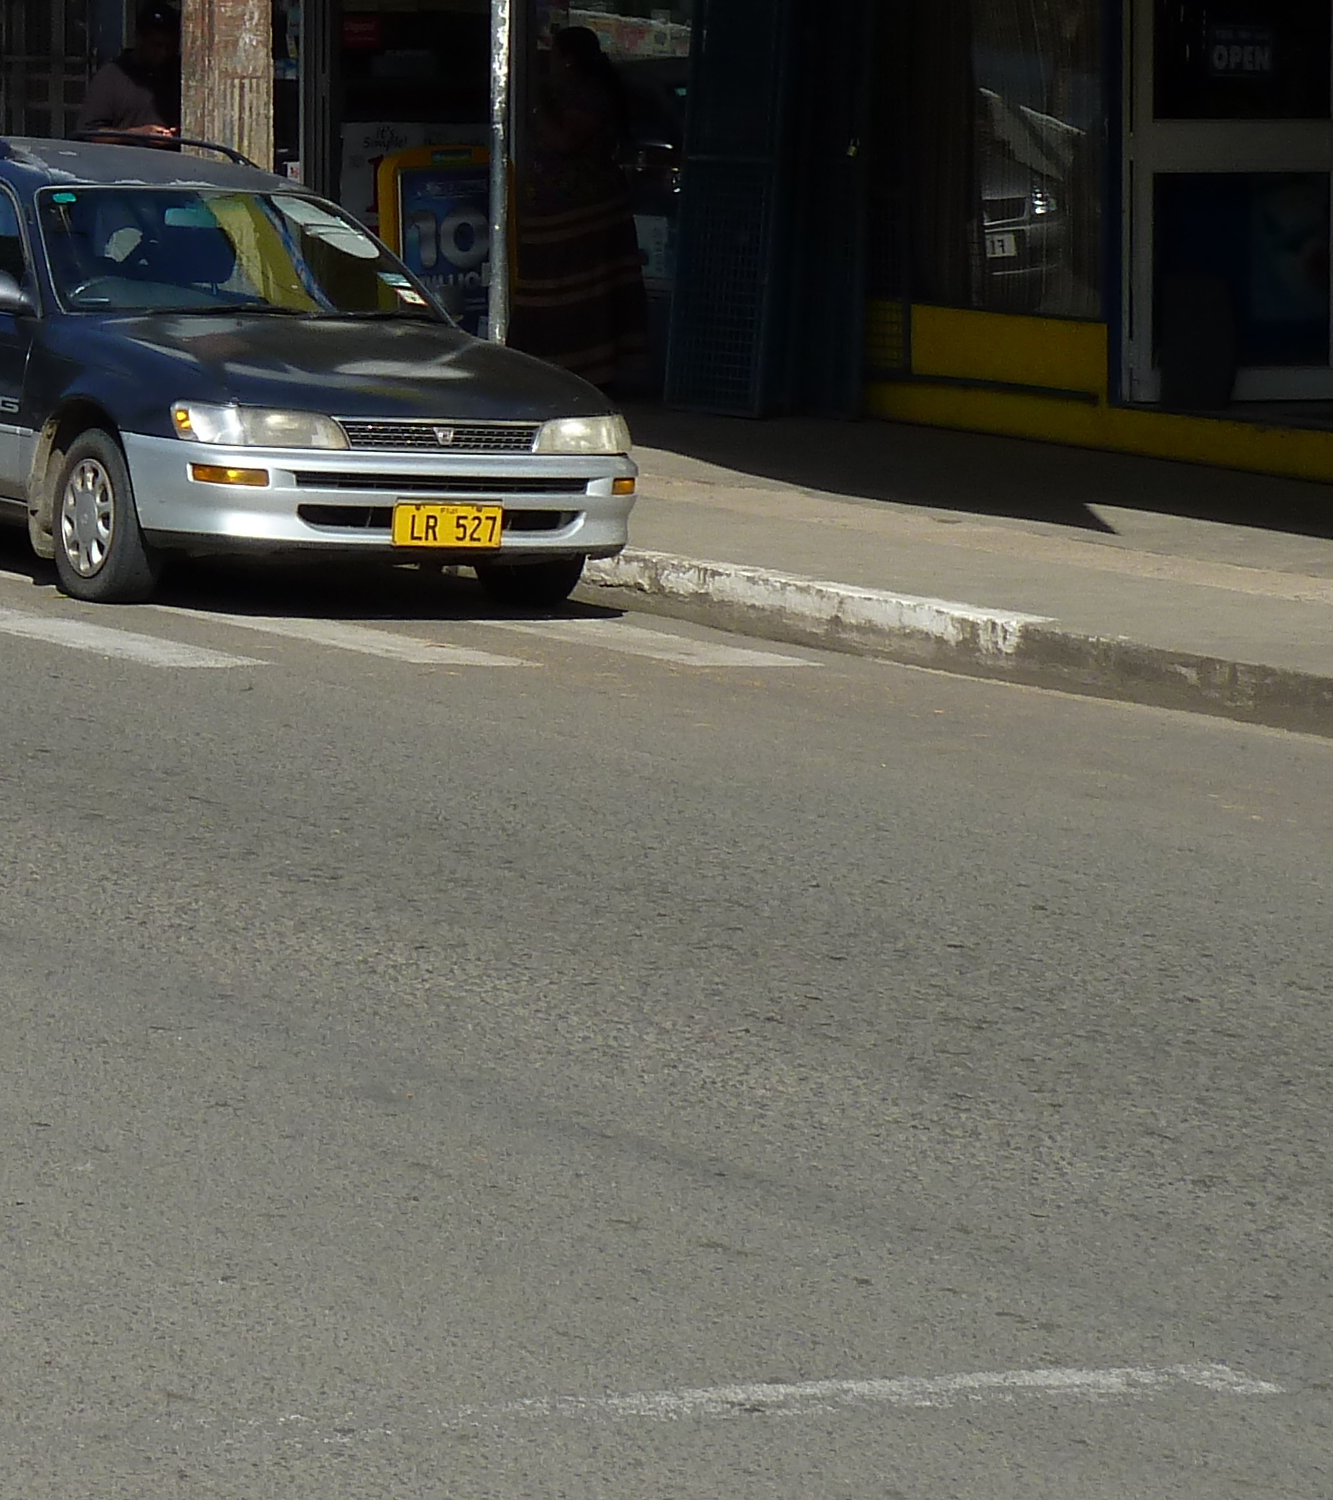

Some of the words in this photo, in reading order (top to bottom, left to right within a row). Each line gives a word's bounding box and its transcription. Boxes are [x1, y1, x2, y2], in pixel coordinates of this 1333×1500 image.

[1212, 44, 1272, 71] OPEN
[405, 209, 490, 269] 10
[410, 514, 438, 542] LR
[455, 515, 497, 543] 527
